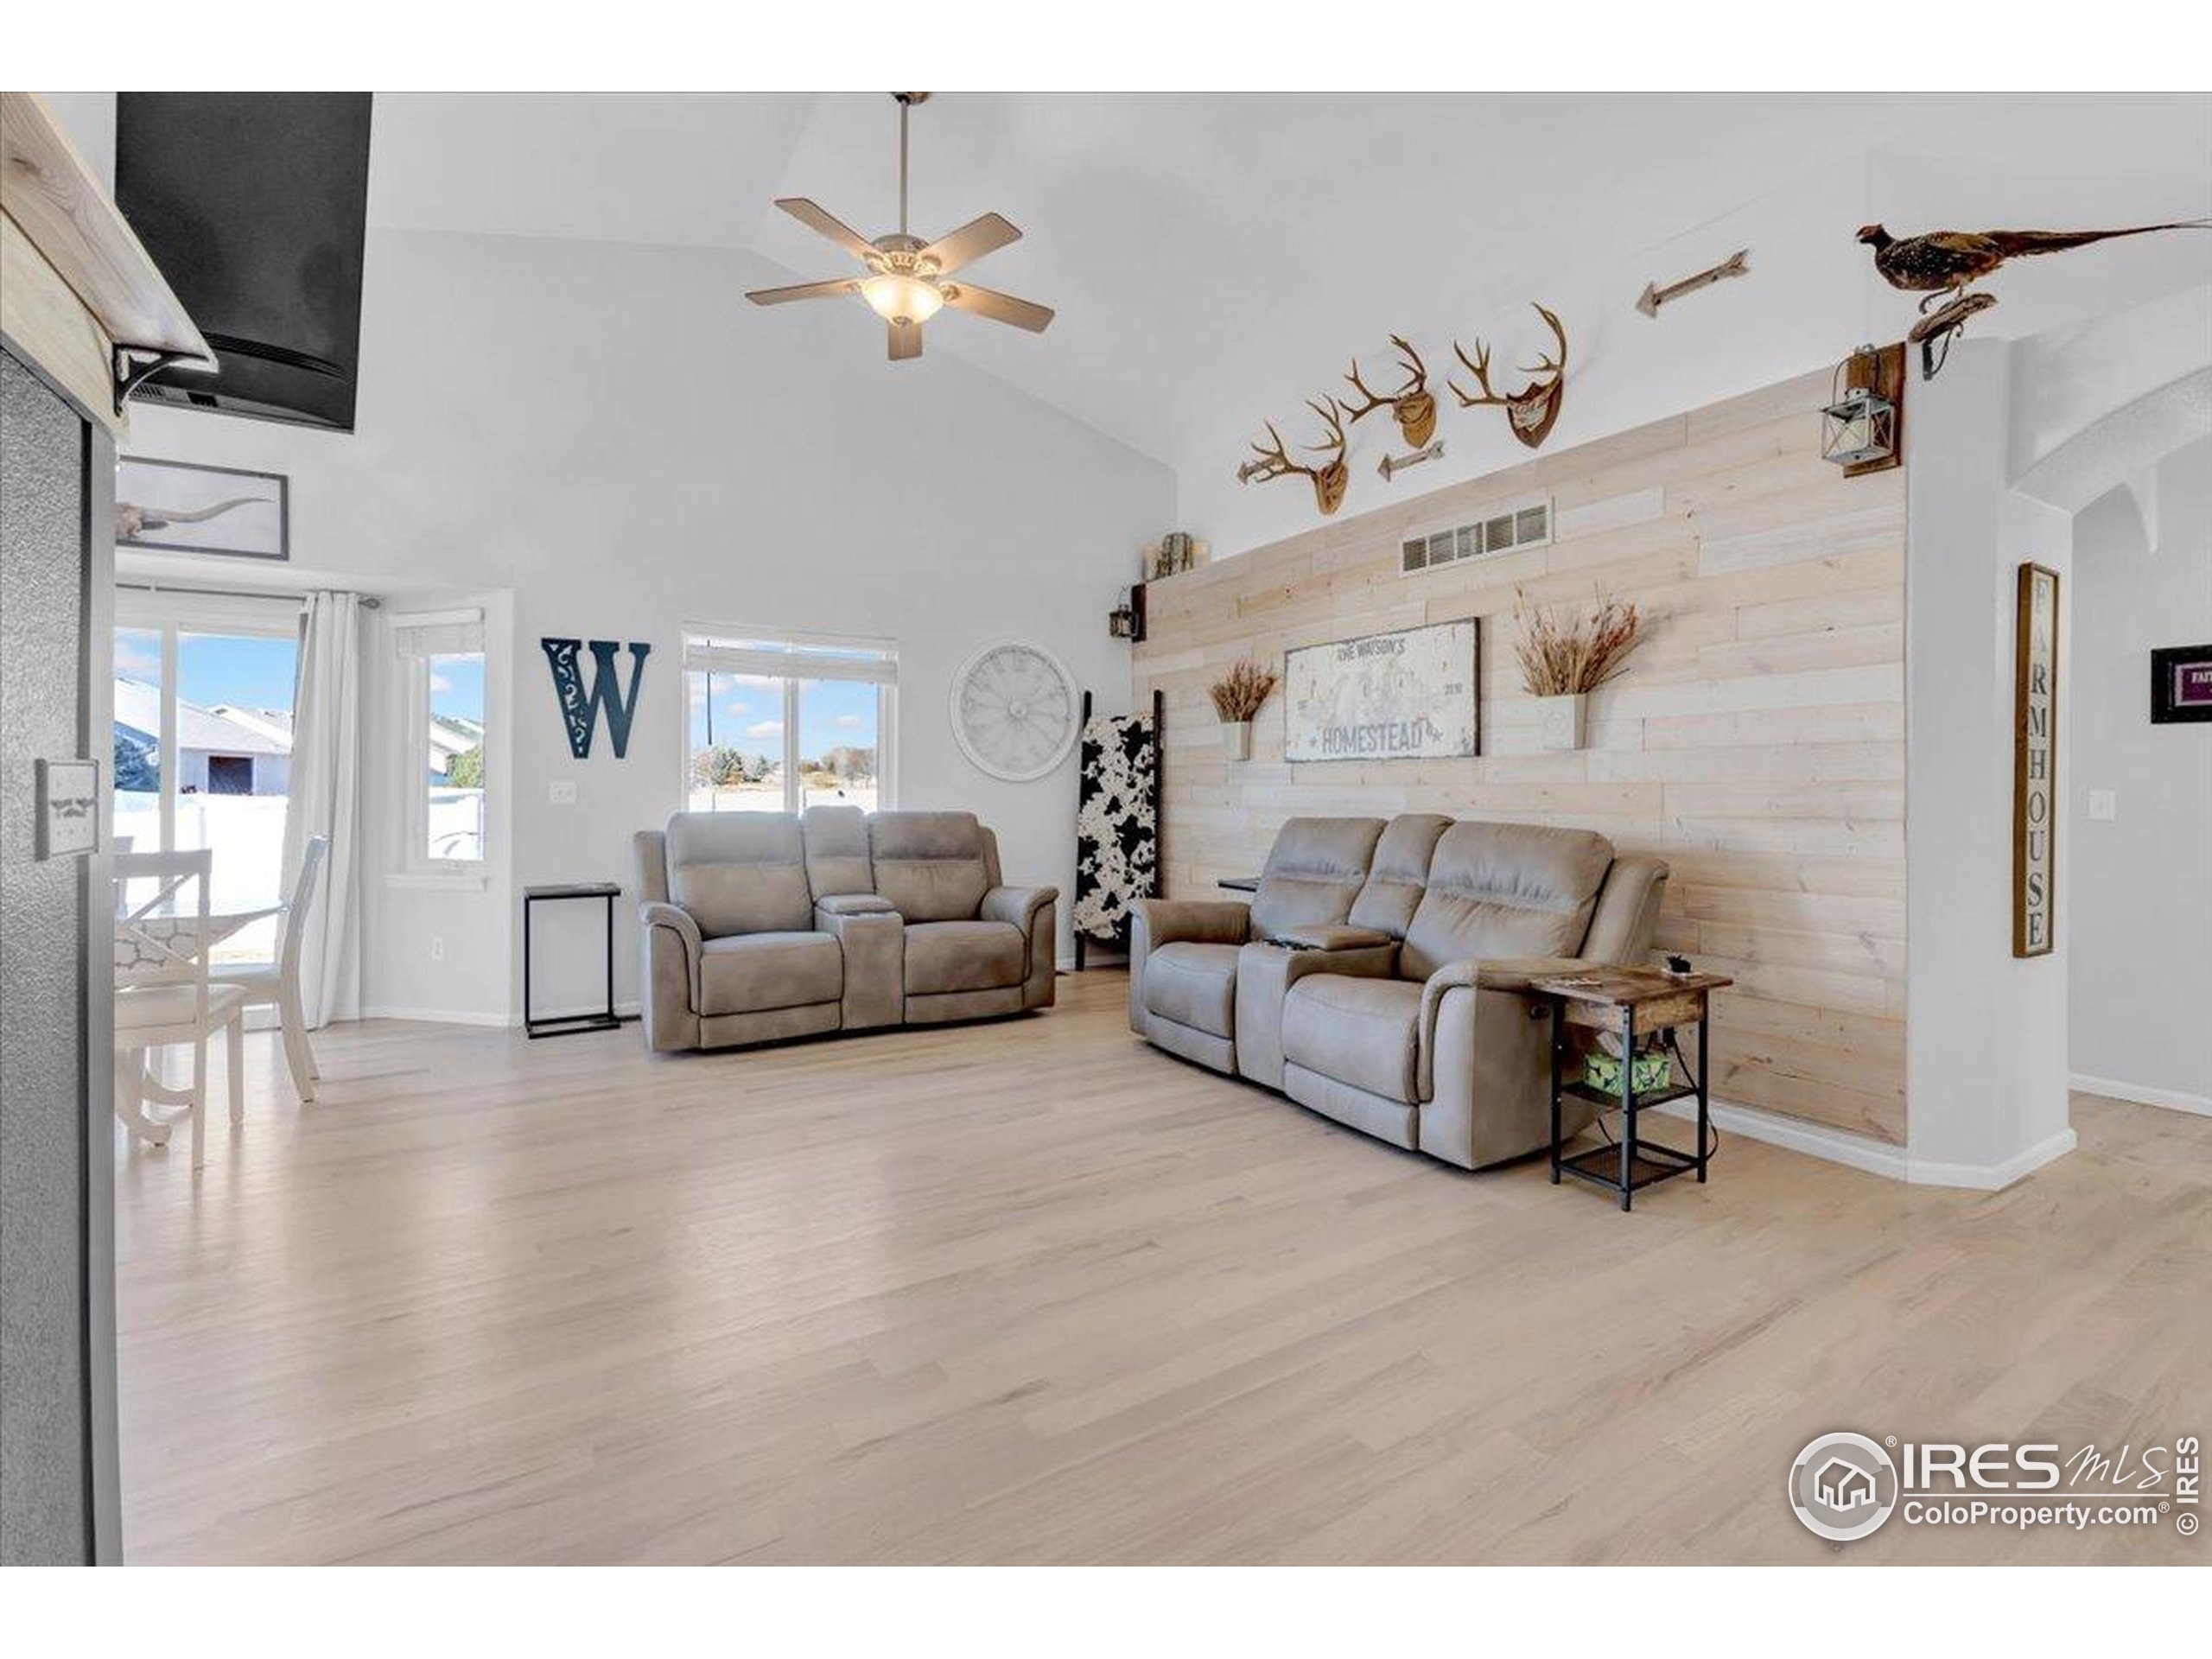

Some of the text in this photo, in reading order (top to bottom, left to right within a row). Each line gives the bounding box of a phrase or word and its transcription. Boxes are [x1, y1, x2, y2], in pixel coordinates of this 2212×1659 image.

[541, 638, 651, 759] W
[1322, 721, 1423, 753] HOMESTEAD
[2027, 578, 2049, 947] FARMHOUSE
